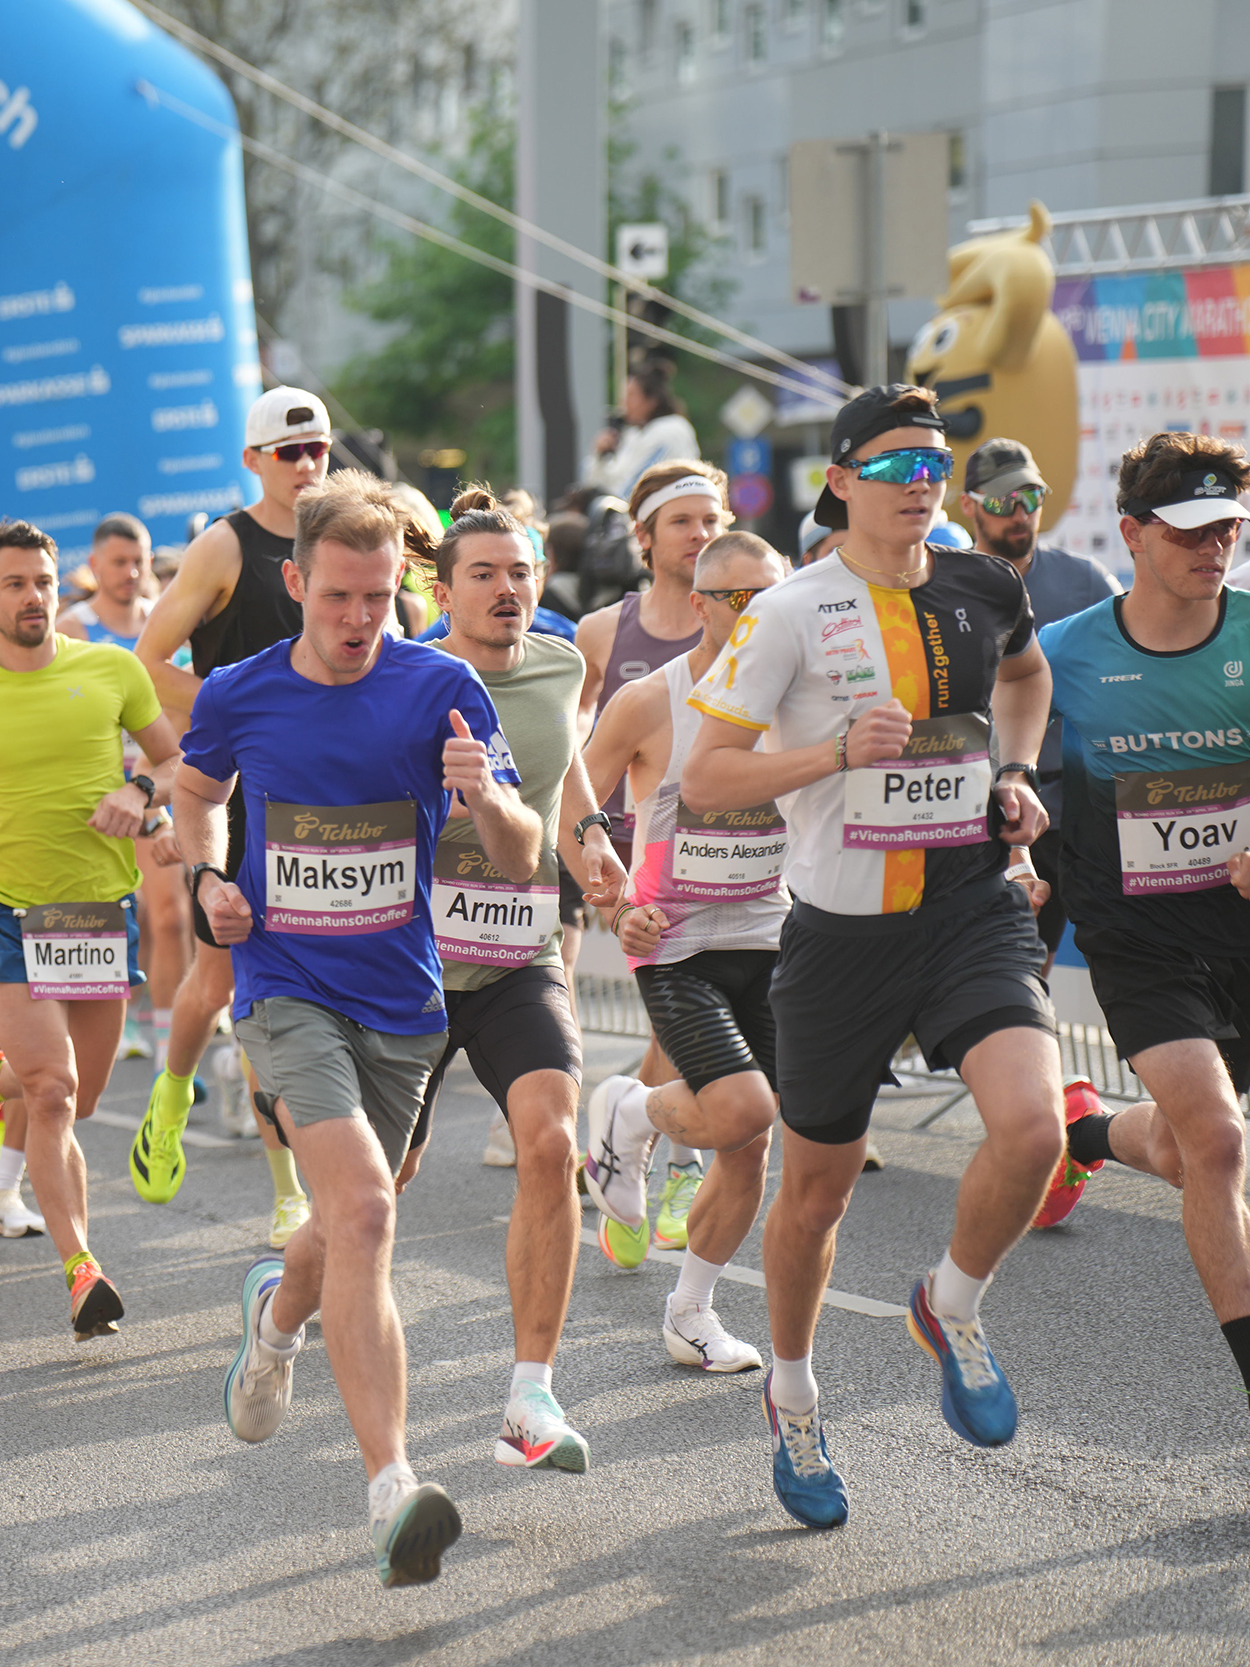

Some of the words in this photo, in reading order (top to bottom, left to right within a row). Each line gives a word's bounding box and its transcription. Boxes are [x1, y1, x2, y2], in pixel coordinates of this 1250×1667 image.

[1085, 304, 1141, 346] VIENNA
[1144, 300, 1182, 342] CITY
[924, 612, 949, 708] run2gether
[1099, 674, 1143, 683] TREK
[1224, 679, 1244, 687] JINGA
[909, 734, 967, 754] Tchibo
[1109, 728, 1244, 753] BUTTONS
[884, 773, 965, 804] Peter
[1173, 782, 1242, 802] Tchibo
[725, 811, 778, 826] Tchibo
[913, 812, 934, 820] 41432
[319, 822, 387, 841] Tchibo
[849, 824, 982, 842] #ViennaRunsOnCoffee
[1152, 820, 1237, 851] Yoav
[679, 841, 729, 859] Anders
[731, 841, 786, 859] Alexander
[1188, 857, 1211, 867] 40489
[277, 855, 404, 897] Maksym
[1128, 868, 1230, 888] #ViennaRunsOn
[677, 881, 777, 897] #ViennaRunsOnCoffee
[330, 900, 353, 908] 42686
[446, 892, 533, 927] Armin
[62, 915, 108, 928] Tchibo
[272, 908, 407, 928] #ViennaRunsOnCoffee
[479, 933, 500, 942] 40612
[35, 942, 115, 966] Martino
[34, 985, 125, 995] #ViennaRunsOnCoffee
